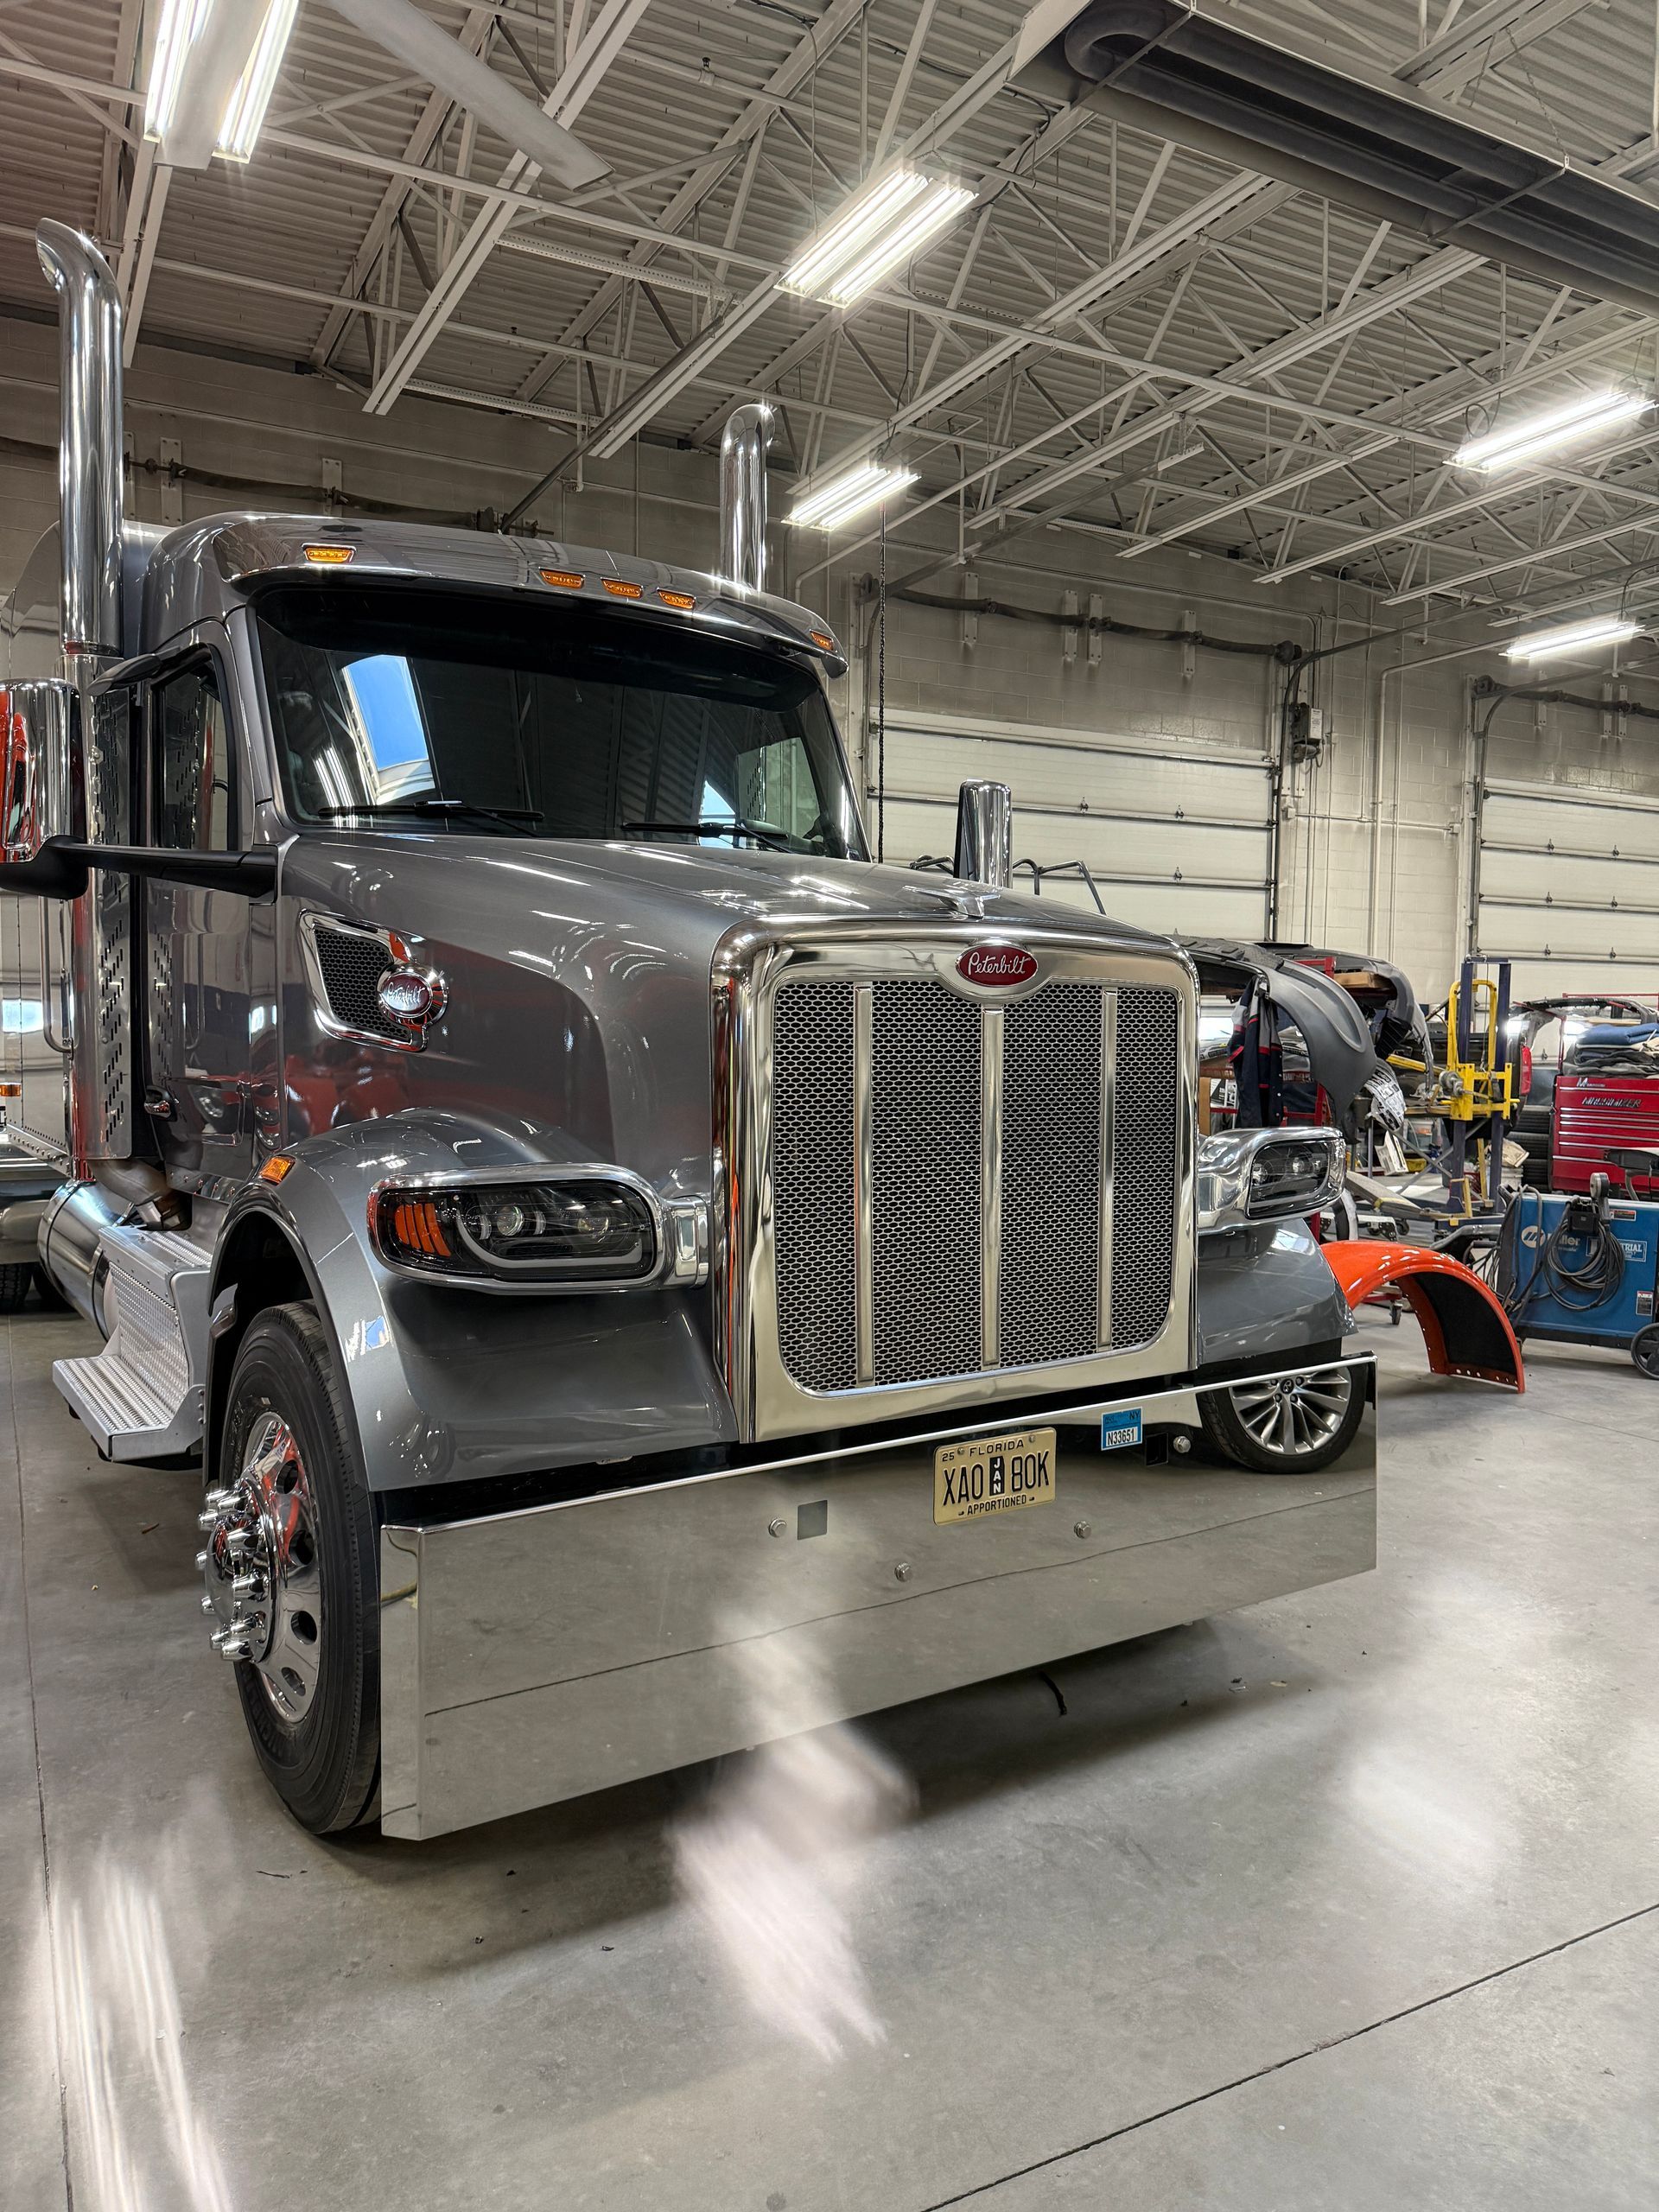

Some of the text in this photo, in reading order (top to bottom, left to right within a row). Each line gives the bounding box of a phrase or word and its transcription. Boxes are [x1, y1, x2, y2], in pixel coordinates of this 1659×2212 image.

[968, 951, 1031, 976] Peterbilt
[1107, 1427, 1135, 1446] N33651
[942, 1439, 1024, 1462] 25 FLORIDA
[993, 1458, 1001, 1493] JAN
[967, 1494, 1027, 1516] APPORTIONED
